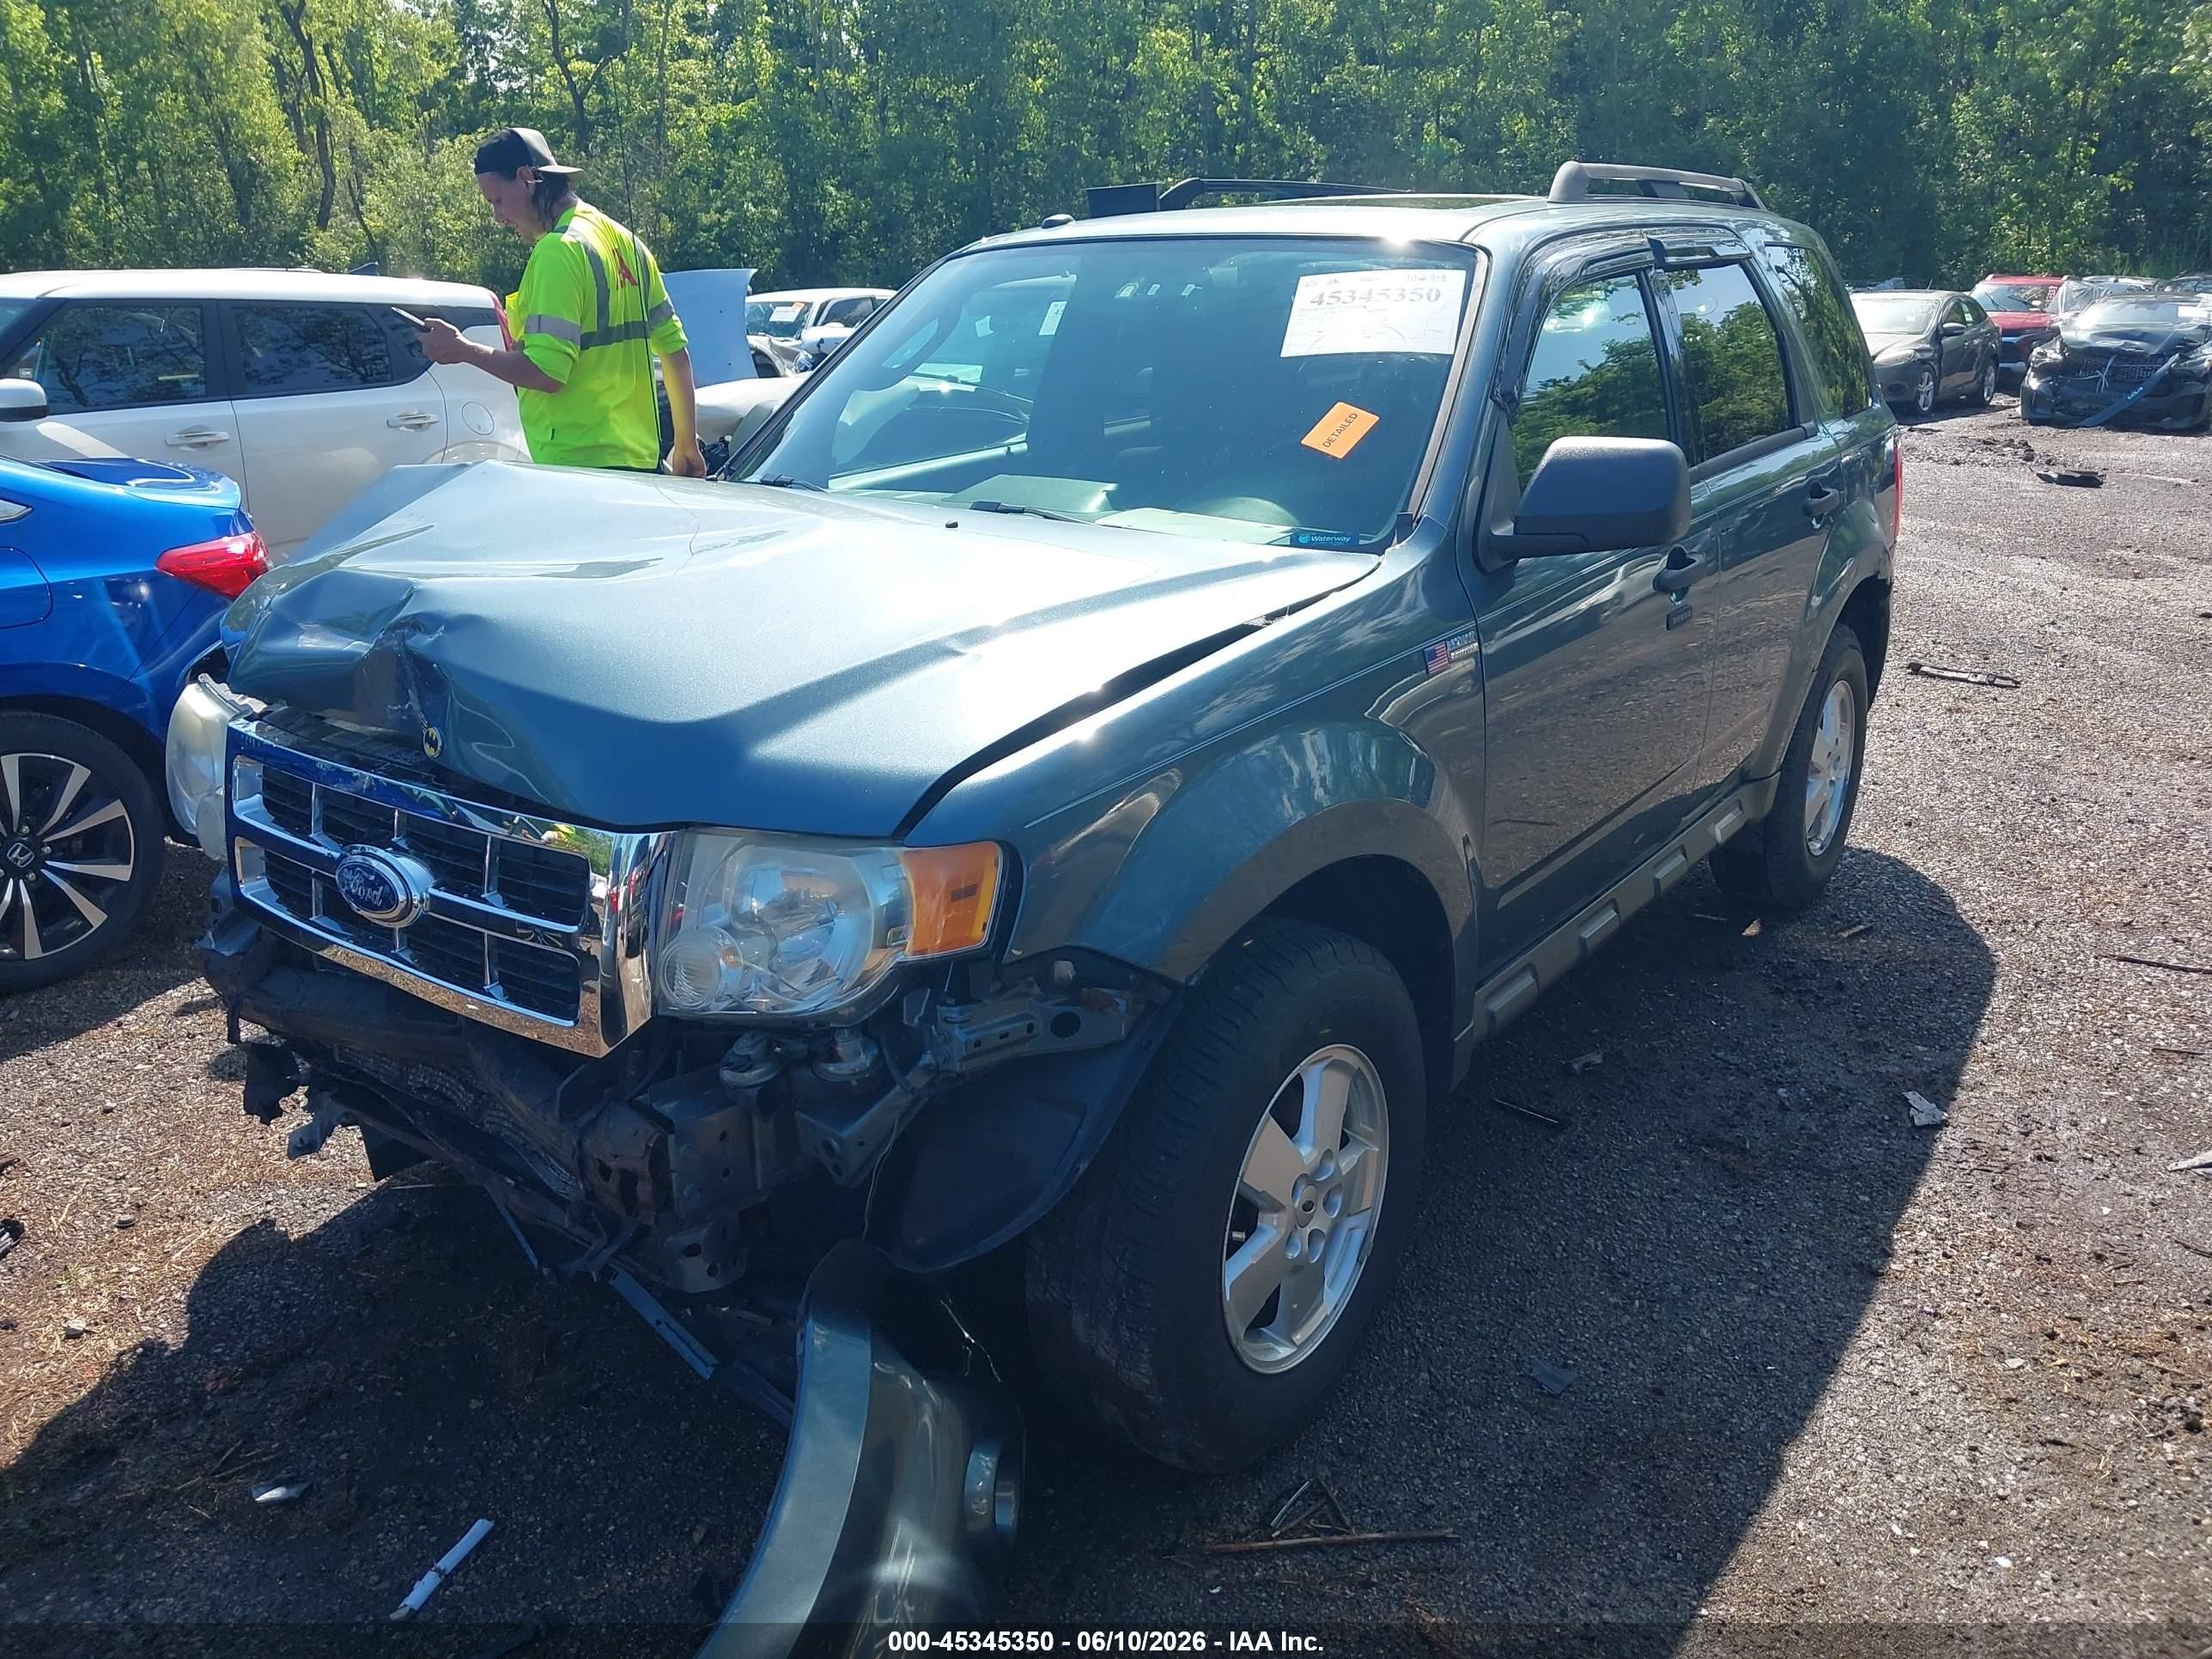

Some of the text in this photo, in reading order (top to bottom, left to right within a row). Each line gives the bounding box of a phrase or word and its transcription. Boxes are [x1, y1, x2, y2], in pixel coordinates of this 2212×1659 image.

[1310, 287, 1442, 307] 45345350
[1322, 412, 1358, 448] DETAILED
[1310, 535, 1352, 544] Waterway
[343, 867, 384, 907] Ford
